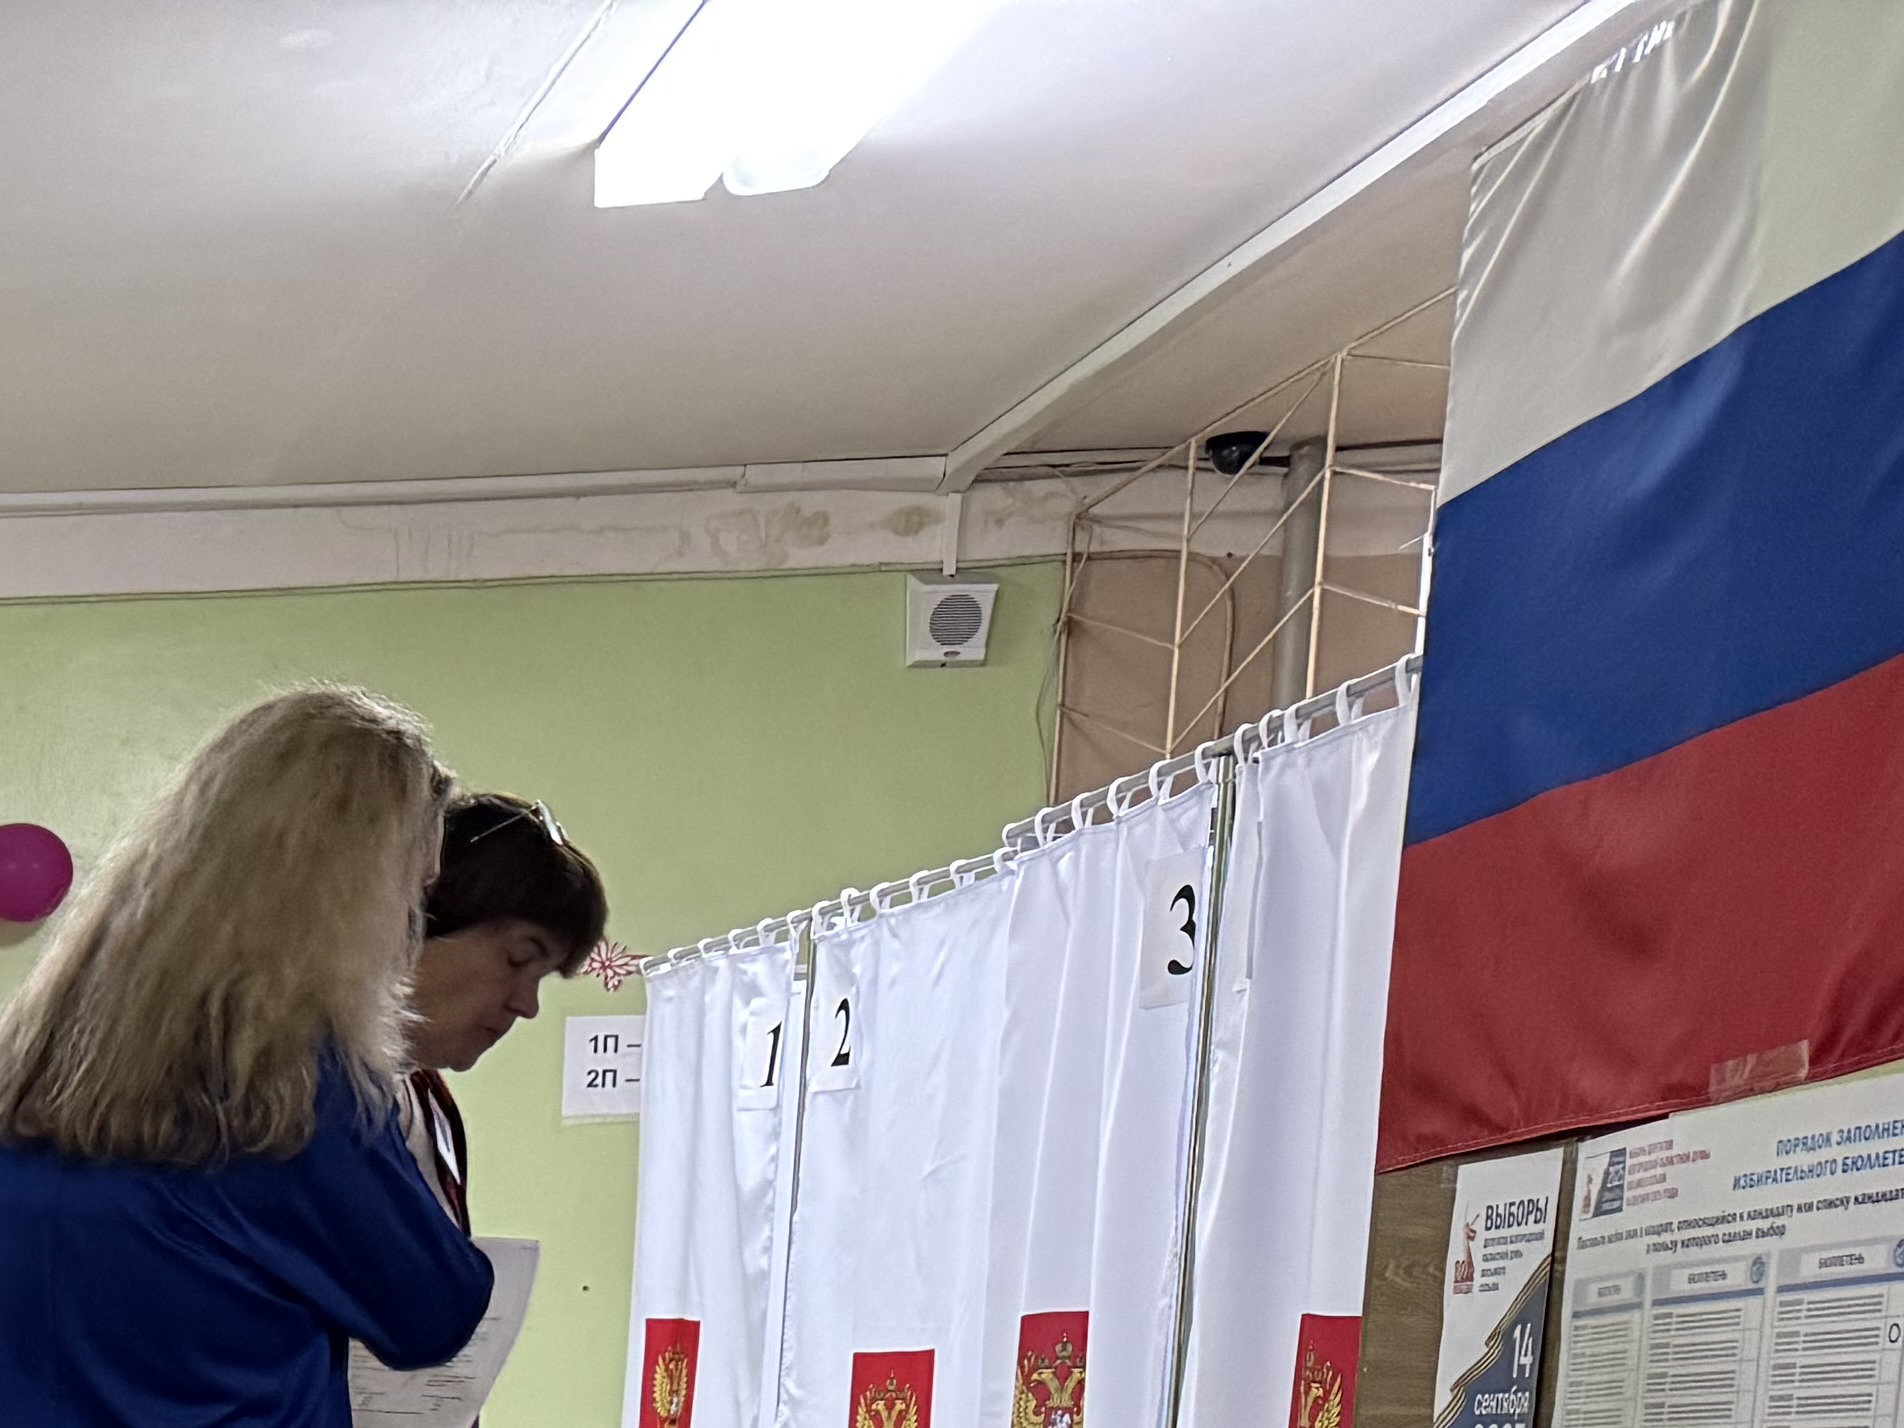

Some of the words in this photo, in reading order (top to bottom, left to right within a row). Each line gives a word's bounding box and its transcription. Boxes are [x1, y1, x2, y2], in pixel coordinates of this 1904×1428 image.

[1168, 884, 1196, 975] 3
[589, 1034, 619, 1054] 1П
[830, 996, 852, 1067] 2
[760, 1021, 783, 1088] 1
[586, 1069, 618, 1089] 2П
[1776, 1131, 1833, 1158] ПОРЯДОК
[1732, 1158, 1838, 1191] ИЗБИРАТЕЛЬНОГО
[1484, 1196, 1550, 1232] ВЫБОРЫ
[1513, 1323, 1534, 1379] 14
[1473, 1385, 1530, 1420] сентября
